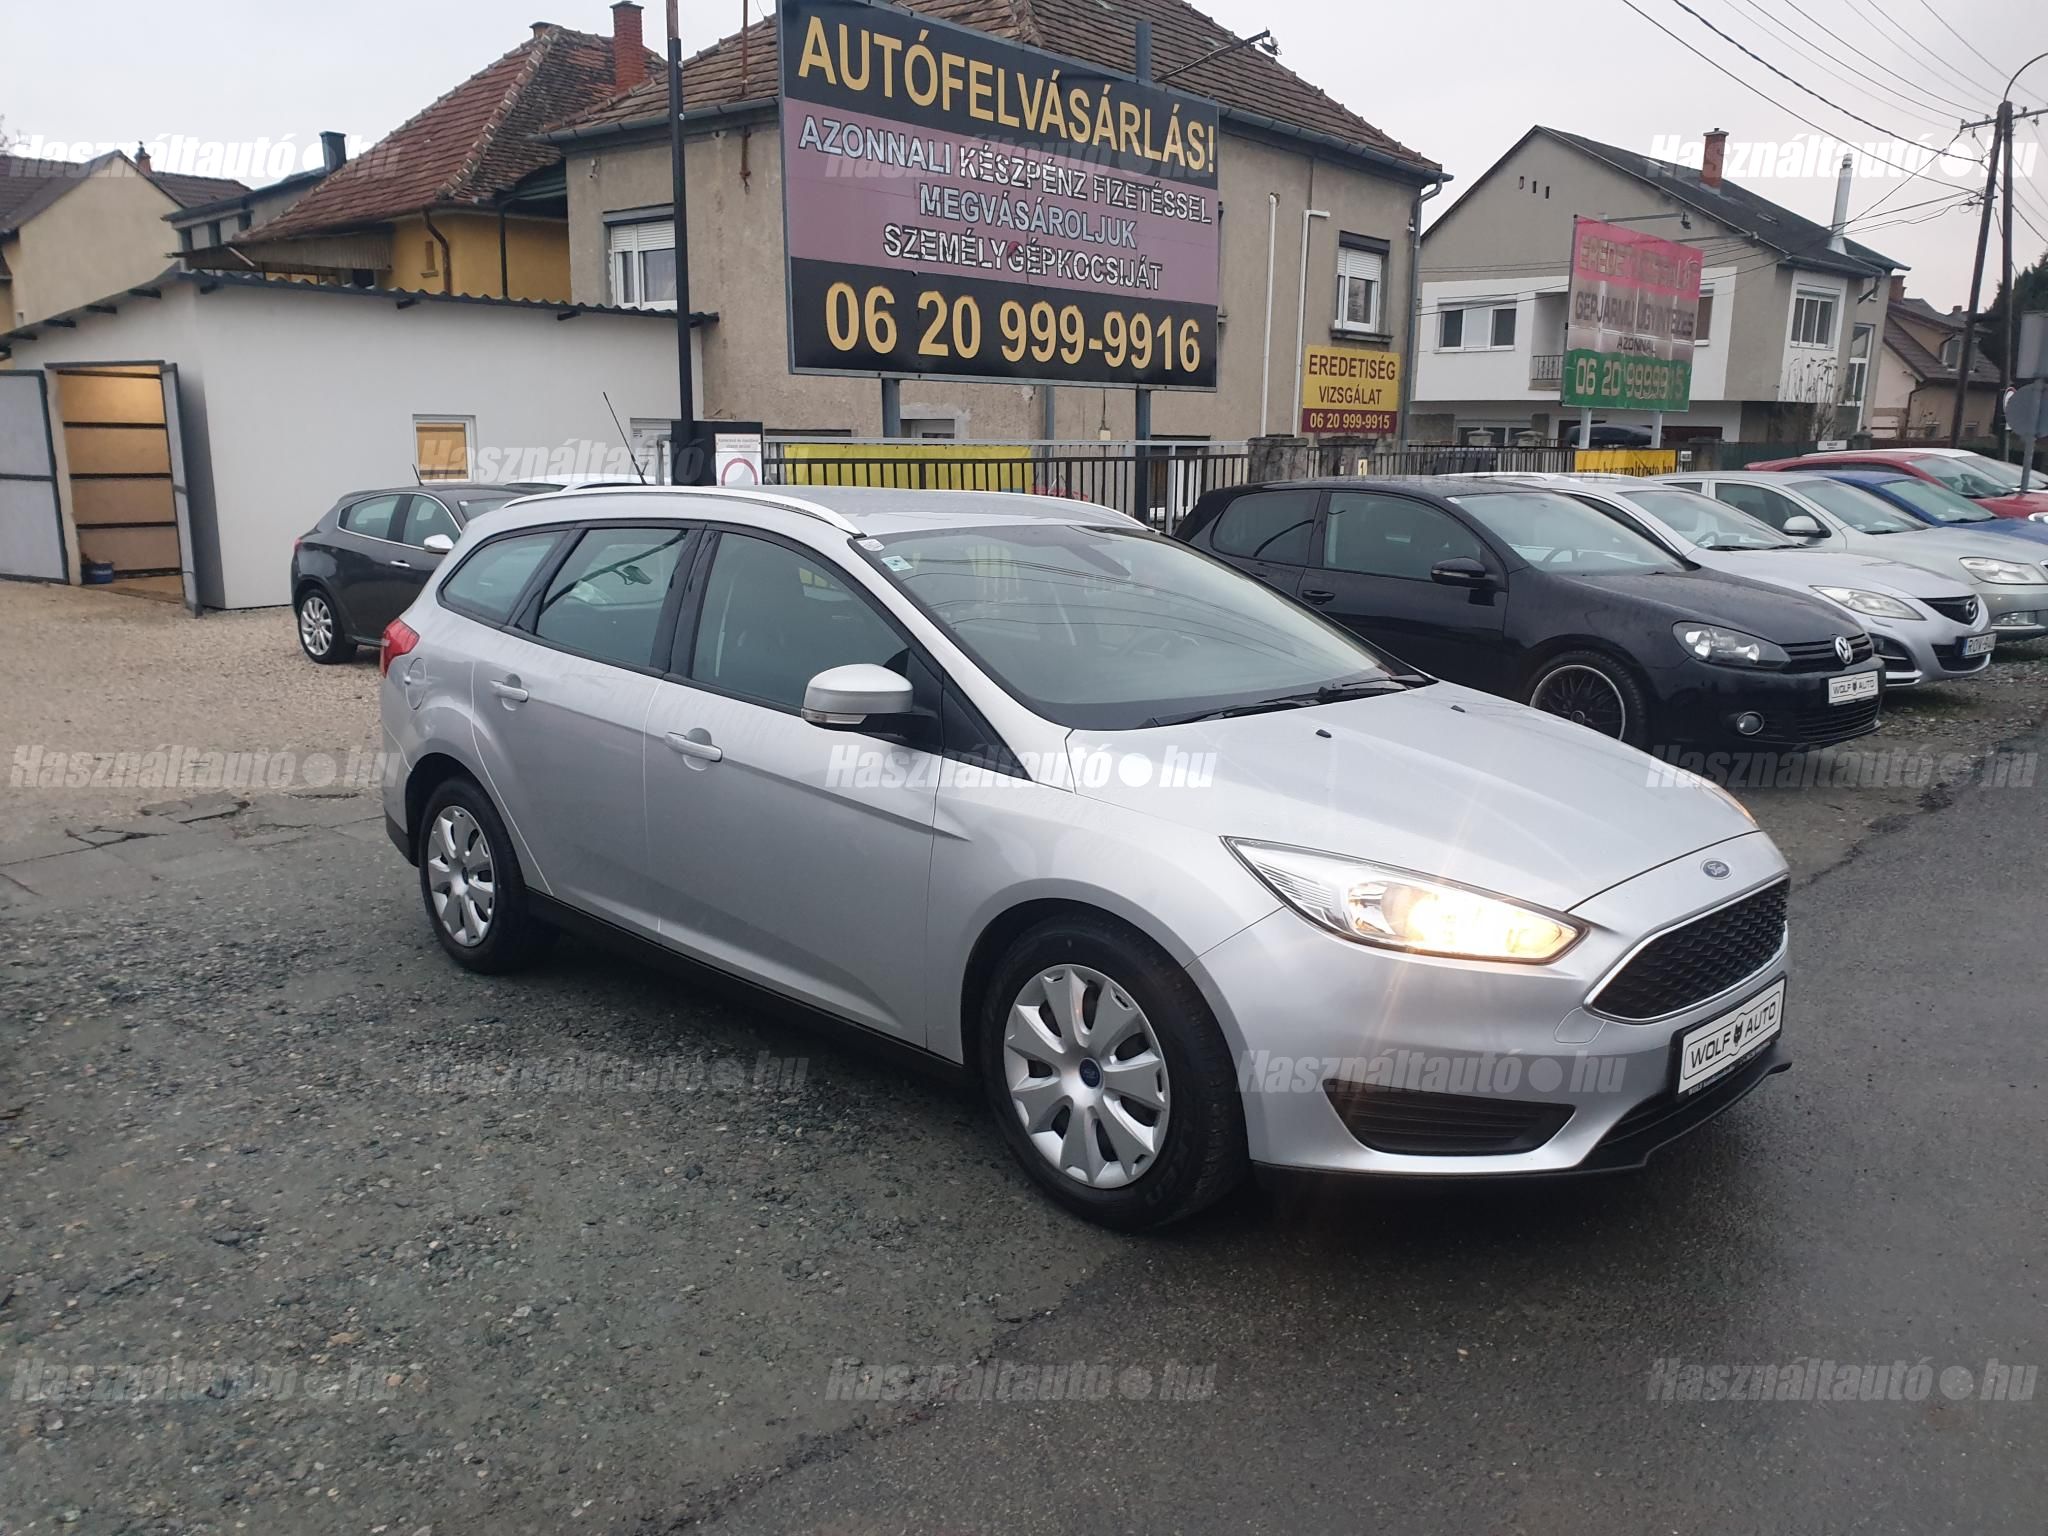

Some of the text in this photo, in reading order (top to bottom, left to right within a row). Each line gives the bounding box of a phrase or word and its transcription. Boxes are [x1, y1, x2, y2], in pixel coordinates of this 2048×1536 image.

[798, 15, 1215, 173] AUTÓFELVÁSÁRLÁS!
[799, 115, 1212, 225] AZONNALI KÉSZPÉNZ FIZETÉSSEL
[919, 184, 1137, 250] MEGVÁSÁROLJUK
[825, 282, 1201, 373] 06 20 999-9916
[1309, 354, 1396, 381] EREDETISÉG
[1575, 358, 1597, 395] 06
[1602, 360, 1621, 397] 20
[1319, 383, 1382, 405] VIZSGÁLAT
[1309, 412, 1390, 430] 06 20 999-9915
[1833, 679, 1874, 695] WOLF AUTO
[1691, 1031, 1731, 1068] WOLF
[1745, 1001, 1776, 1038] AUTO
